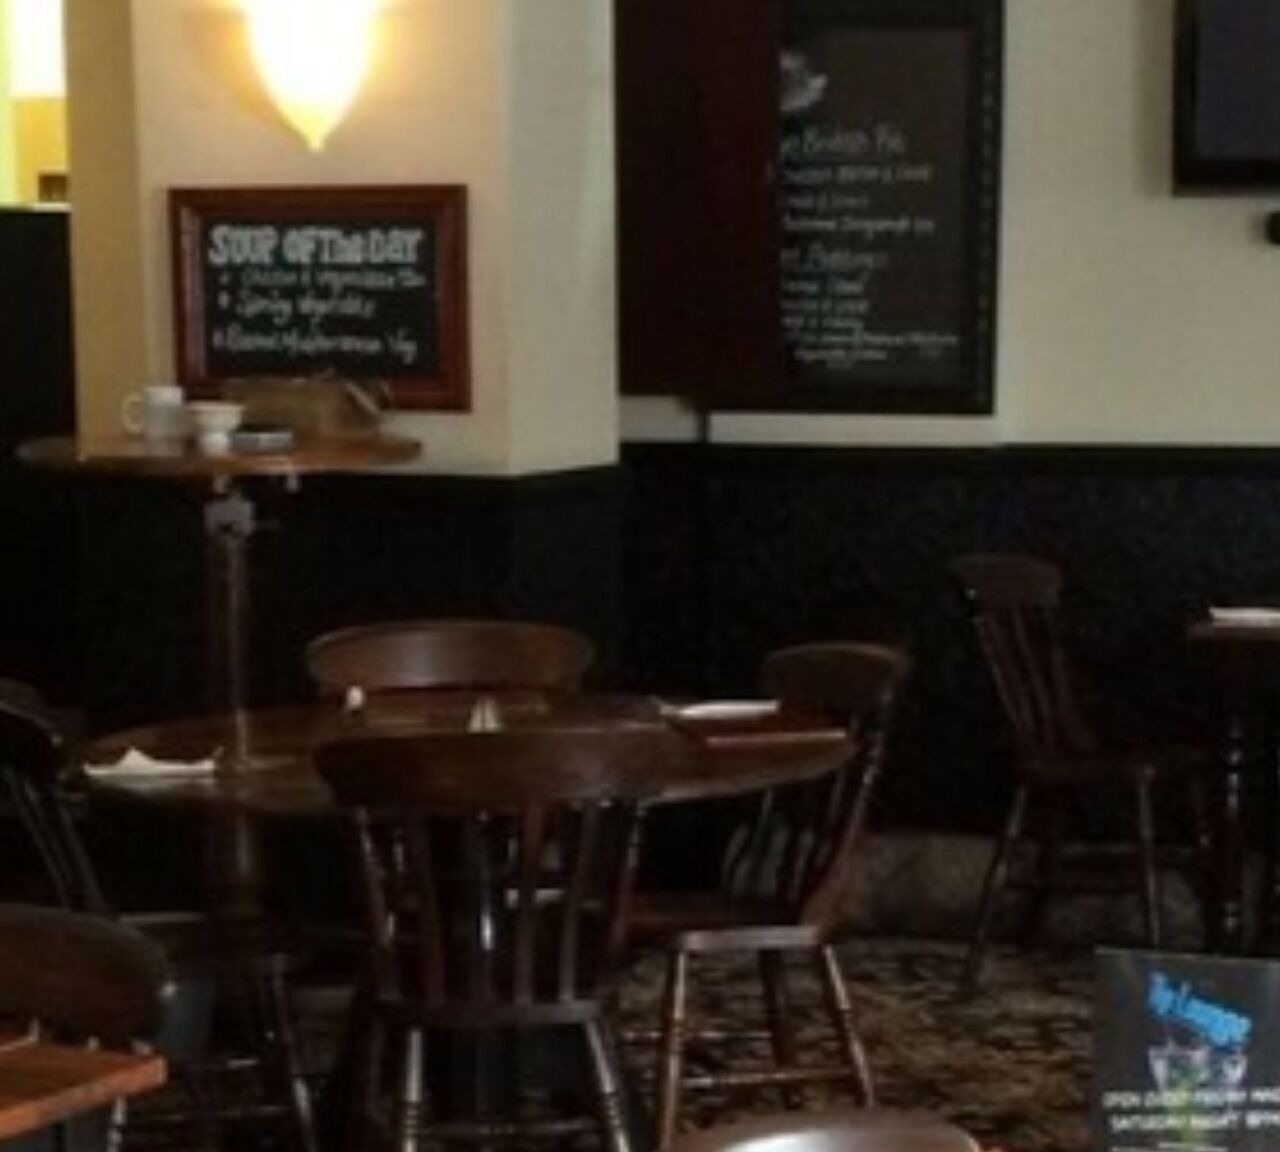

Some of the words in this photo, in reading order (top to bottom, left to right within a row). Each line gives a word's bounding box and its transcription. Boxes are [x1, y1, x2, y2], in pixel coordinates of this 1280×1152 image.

[209, 224, 278, 264] SOUP
[282, 227, 318, 263] OF
[369, 228, 423, 263] DAY
